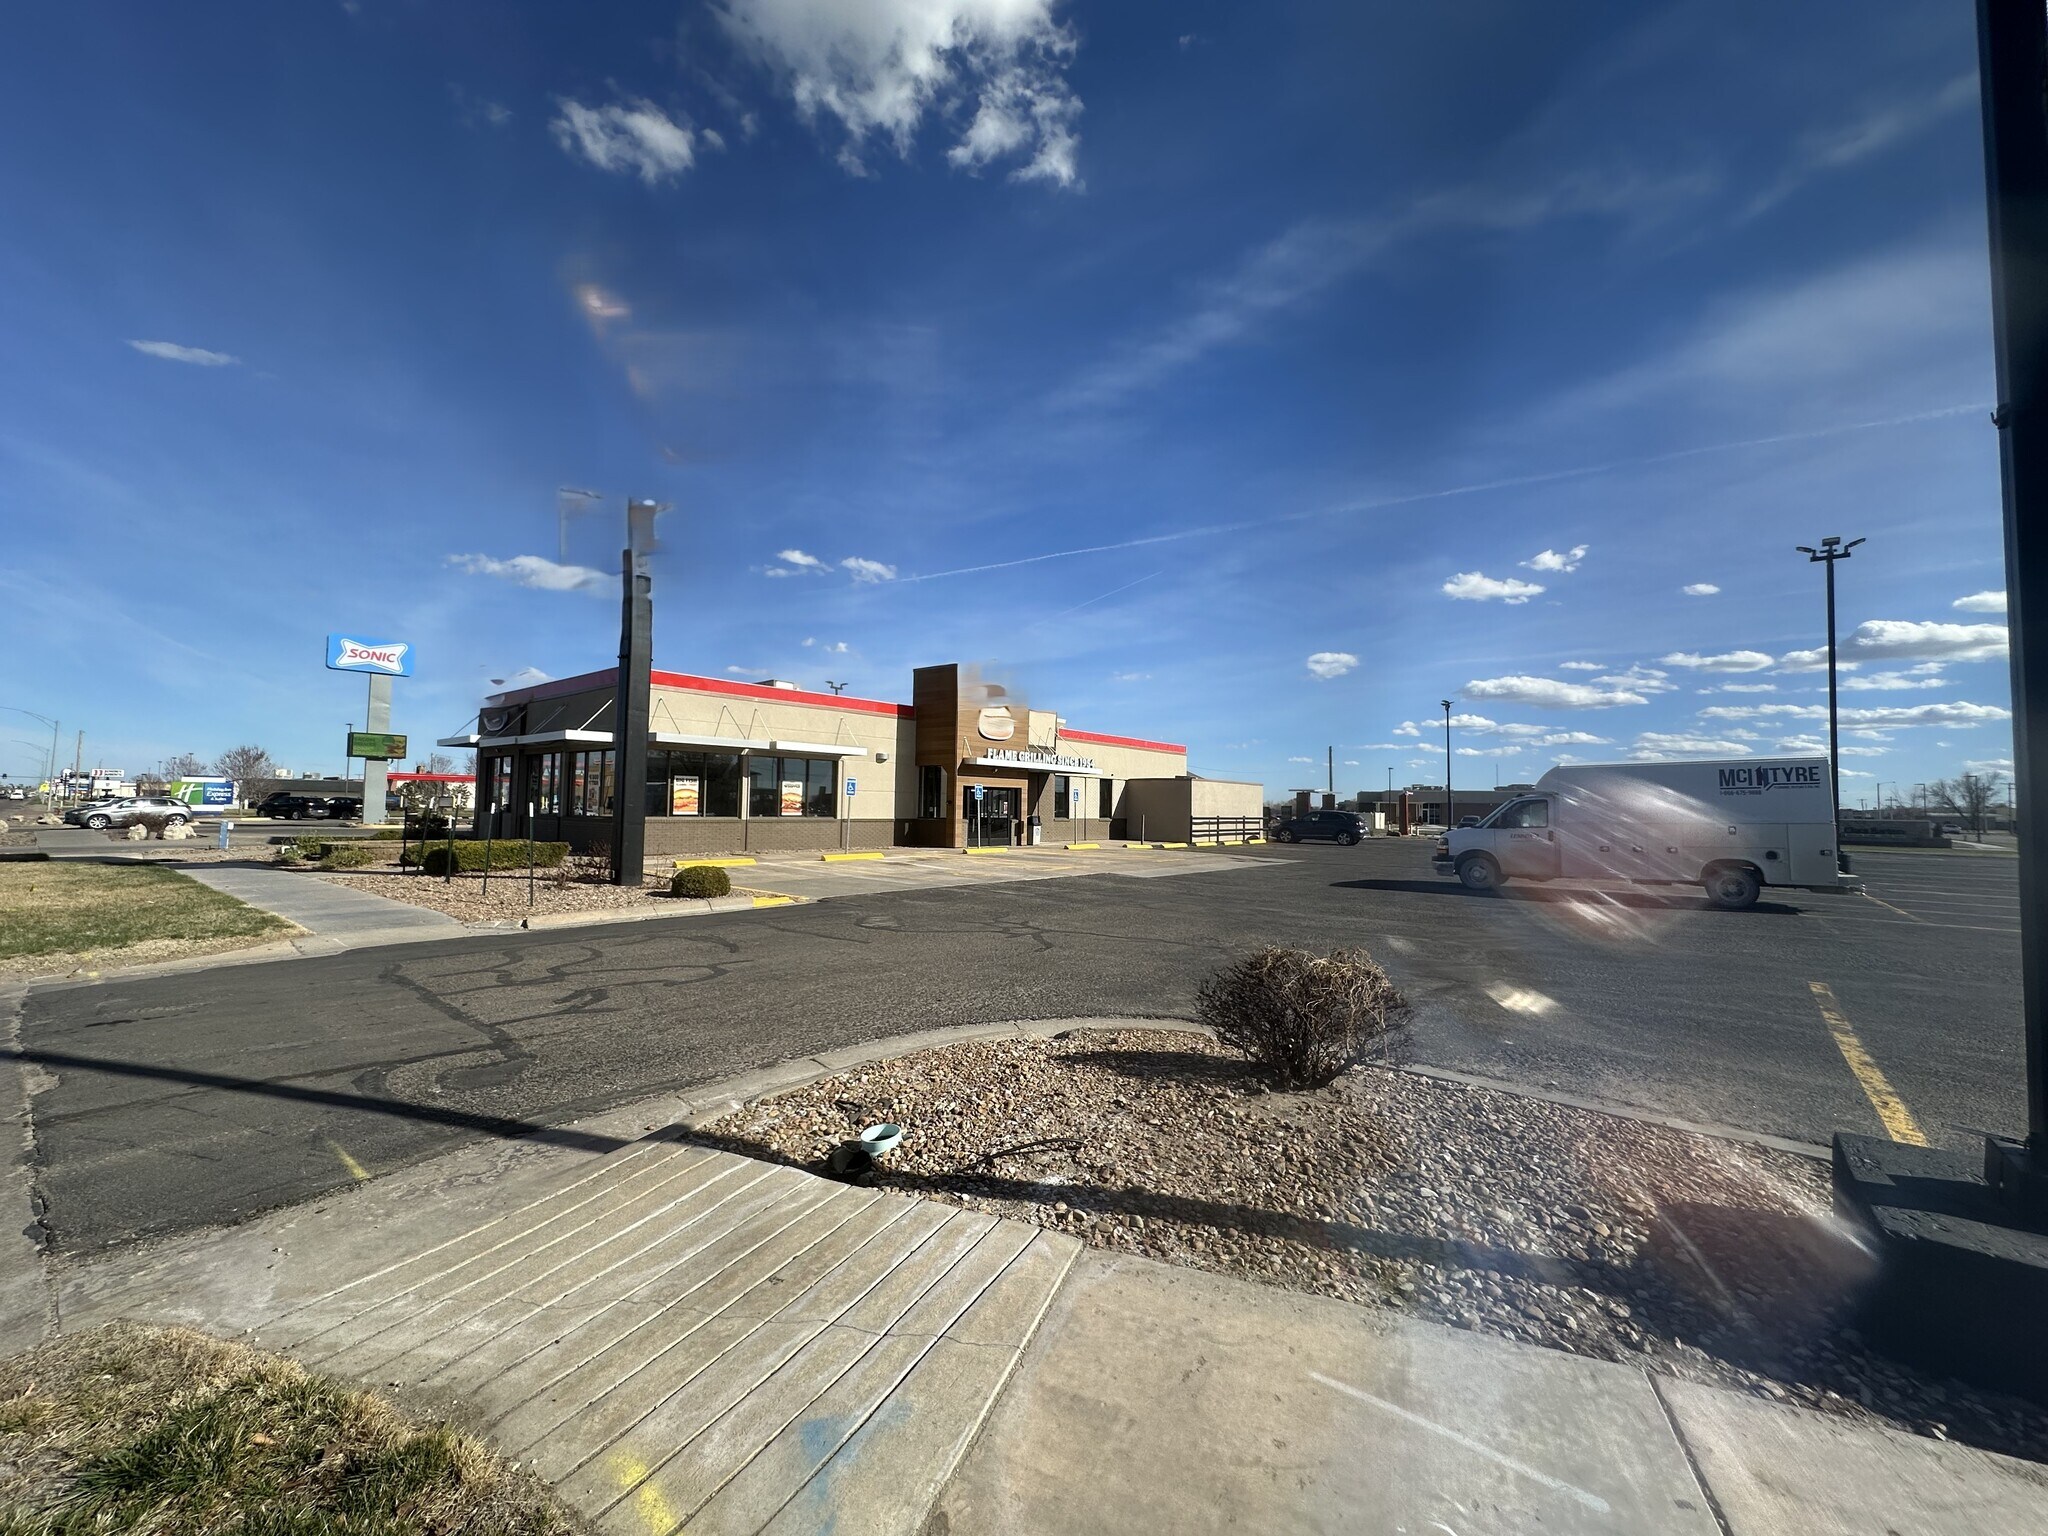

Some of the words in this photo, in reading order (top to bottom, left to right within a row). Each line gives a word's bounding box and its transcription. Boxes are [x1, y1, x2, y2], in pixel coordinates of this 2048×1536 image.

[347, 648, 397, 663] SONIC
[987, 748, 1018, 761] FLAME
[1018, 751, 1057, 765] GRILLING
[1056, 755, 1079, 767] SINCE
